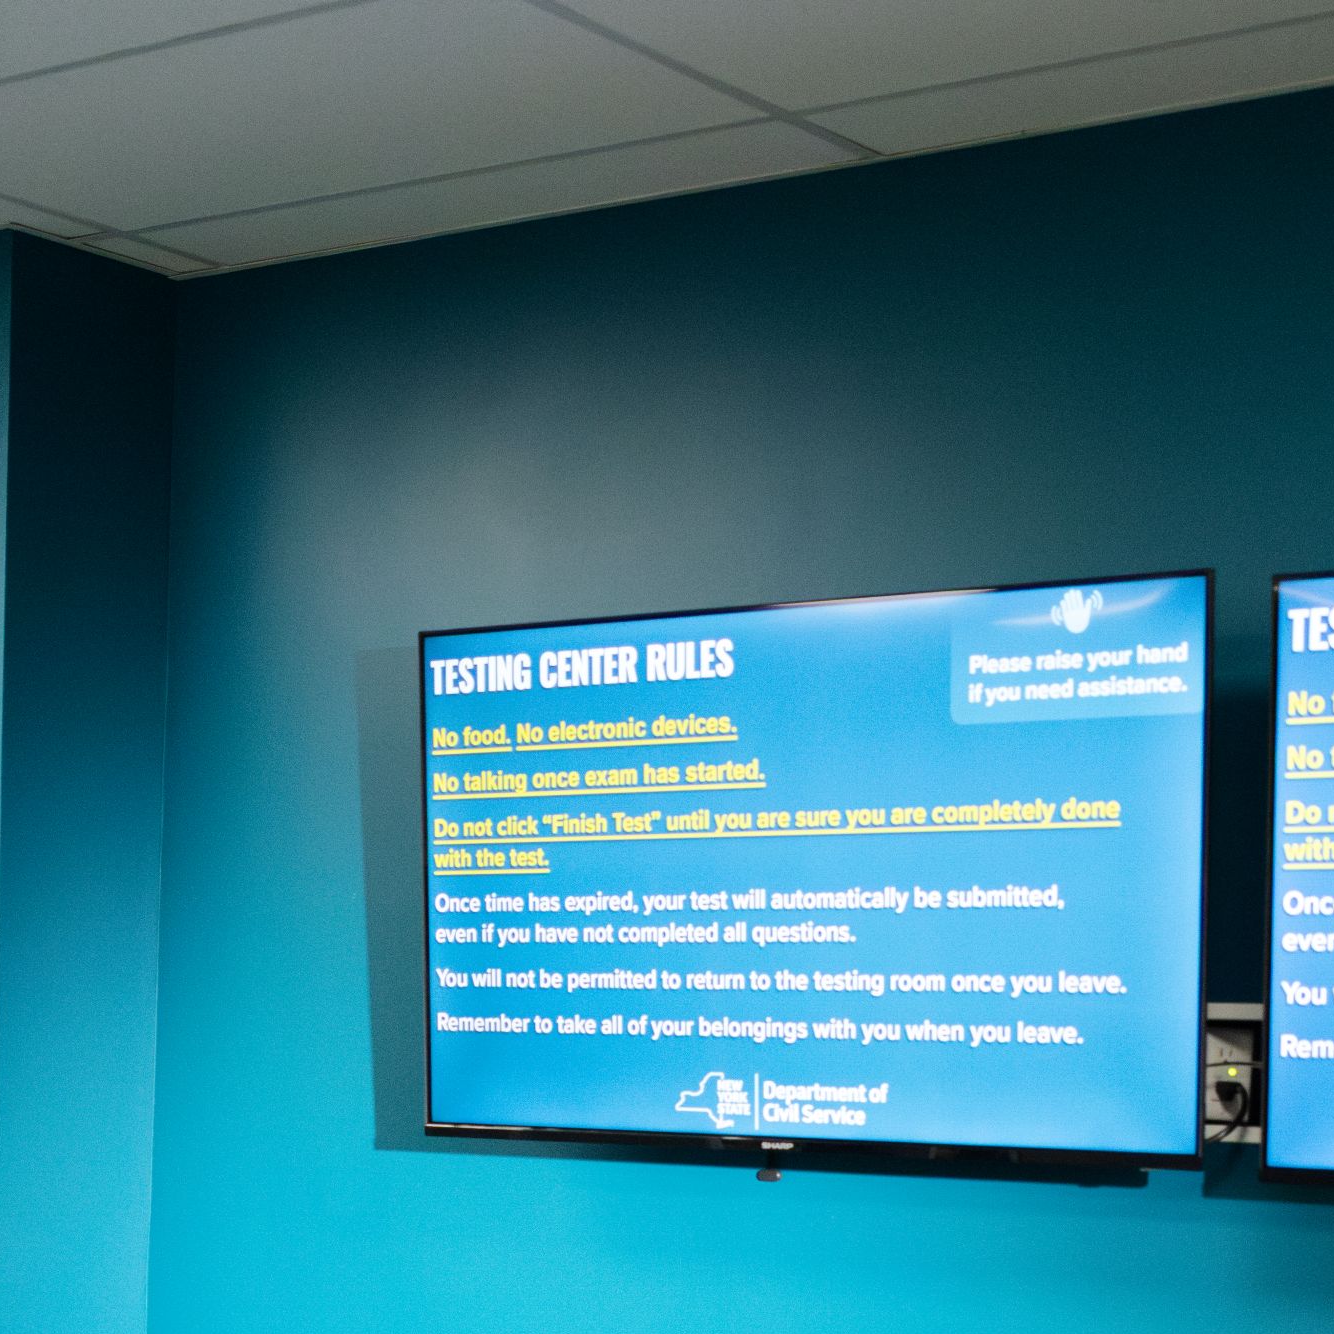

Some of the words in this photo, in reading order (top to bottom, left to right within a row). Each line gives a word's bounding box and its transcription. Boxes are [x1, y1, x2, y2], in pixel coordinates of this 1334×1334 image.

[431, 653, 532, 695] TESTING
[539, 645, 637, 688] CENTER
[646, 638, 734, 681] RULES
[969, 653, 1031, 674] Please
[1036, 648, 1083, 671] raise
[1087, 649, 1132, 672] your
[1136, 642, 1188, 664] hand
[968, 682, 985, 703] if
[985, 683, 1021, 707] you
[1025, 678, 1073, 700] need
[1077, 674, 1187, 698] assistance.
[1288, 691, 1325, 716] No
[432, 727, 458, 748] No
[463, 725, 511, 746] food.
[516, 723, 543, 743] No
[548, 716, 646, 741] electronic
[651, 714, 737, 737] devices.
[1286, 745, 1323, 771] No
[433, 773, 459, 792] No
[463, 770, 527, 792] talking
[532, 768, 580, 789] once
[584, 768, 638, 786] exam
[643, 763, 680, 784] has
[685, 758, 765, 783] started.
[434, 818, 459, 838] Do
[463, 817, 492, 836] not
[497, 815, 538, 836] click
[542, 813, 607, 835] “Finish
[612, 811, 661, 833] Test”
[666, 809, 709, 831] until
[714, 813, 752, 833] you
[756, 811, 791, 828] are
[795, 807, 841, 828] sure
[845, 805, 885, 829] you
[890, 806, 926, 824] are
[932, 798, 1055, 824] completely
[1061, 796, 1121, 821] done
[434, 849, 471, 868] with
[476, 847, 505, 867] the
[510, 848, 549, 867] test.
[435, 893, 480, 913] Once
[484, 893, 523, 912] time
[528, 893, 561, 912] has
[564, 891, 639, 915] expired,
[643, 894, 686, 915] your
[690, 891, 727, 911] test
[732, 889, 765, 910] will
[771, 887, 909, 913] automatically
[914, 886, 942, 909] be
[946, 885, 1065, 910] submitted,
[435, 927, 477, 944] even
[481, 923, 494, 943] if
[497, 928, 530, 947] you
[535, 923, 578, 943] have
[583, 924, 614, 943] not
[618, 922, 718, 947] completed
[723, 922, 746, 943] all
[751, 921, 857, 947] questions.
[436, 968, 468, 987] You
[472, 968, 501, 988] will
[506, 969, 535, 988] not
[539, 968, 562, 988] be
[567, 968, 657, 993] permitted
[662, 970, 681, 989] to
[686, 970, 745, 990] return
[750, 970, 771, 990] to
[775, 969, 808, 991] the
[813, 969, 885, 996] testing
[890, 973, 945, 991] room
[951, 974, 1005, 993] once
[1010, 975, 1052, 997] you
[1059, 970, 1127, 994] leave.
[437, 1012, 530, 1032] Remember
[534, 1014, 552, 1033] to
[557, 1014, 596, 1034] take
[601, 1015, 623, 1035] all
[627, 1015, 647, 1035] of
[651, 1020, 693, 1040] your
[698, 1016, 808, 1043] belongings
[813, 1018, 856, 1040] with
[860, 1022, 900, 1045] you
[905, 1019, 964, 1041] when
[969, 1025, 1011, 1047] you
[1017, 1021, 1084, 1045] leave.
[718, 1080, 743, 1091] NEW
[763, 1080, 867, 1105] Department
[868, 1083, 889, 1103] of
[718, 1104, 750, 1116] STATE
[763, 1103, 799, 1122] Civil
[801, 1106, 865, 1126] Service
